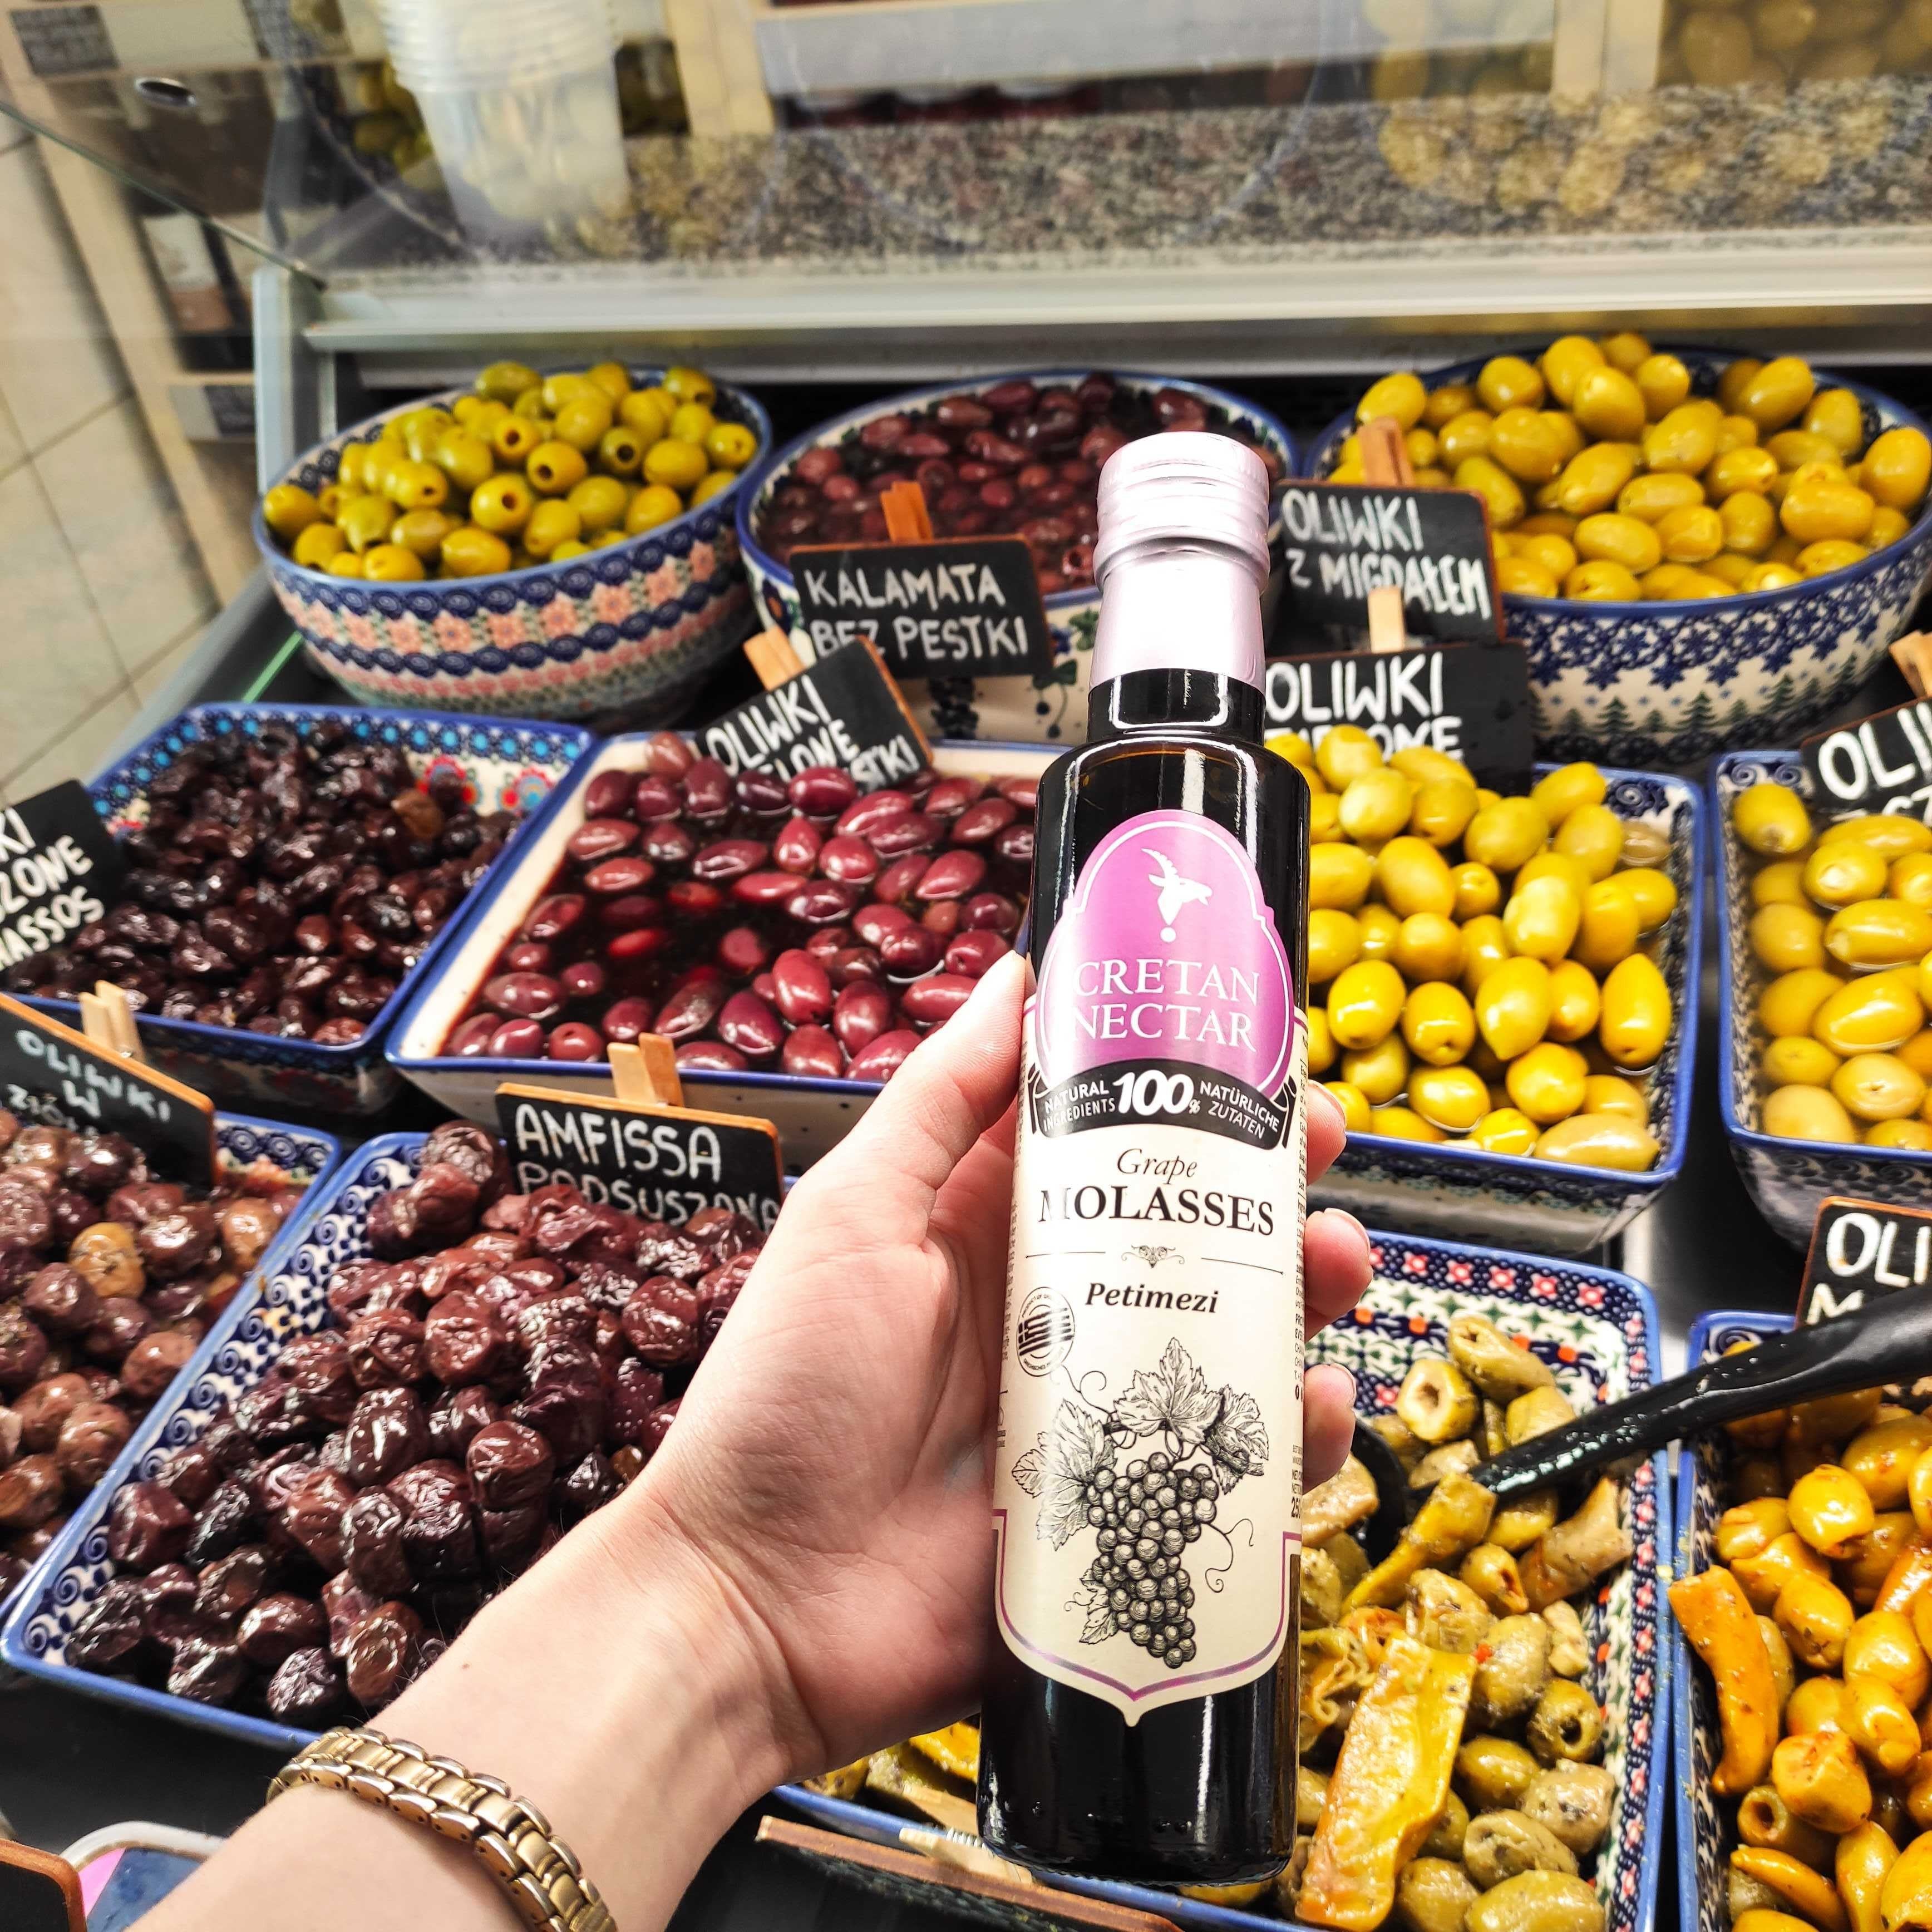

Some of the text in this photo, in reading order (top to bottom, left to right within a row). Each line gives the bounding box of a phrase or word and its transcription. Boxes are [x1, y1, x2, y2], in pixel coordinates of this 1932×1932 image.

[1282, 488, 1424, 551] OLIWKI
[805, 563, 1006, 611] KALAMATA
[1285, 548, 1312, 588] Z
[810, 615, 1029, 661] BEZ PESTKI
[1265, 652, 1443, 723] OLIWKI
[706, 674, 832, 777] OLIWKI
[842, 734, 920, 793] STKI
[1818, 702, 1932, 800] OLI
[0, 835, 93, 924] ZONE
[1072, 958, 1260, 1006] CRETAN
[1071, 1003, 1257, 1052] NECTAR
[15, 1029, 171, 1122] OLIWKI
[1044, 1080, 1110, 1114] NATURAL
[1043, 1097, 1116, 1132] INGREDIENTS
[1200, 1080, 1280, 1133] NATÜRLICHE
[1208, 1101, 1265, 1139] ZUTATEN
[515, 1103, 721, 1183] AMFISSA
[1117, 1148, 1197, 1185] Grape
[1038, 1185, 1274, 1236] MOLASSES
[1085, 1282, 1219, 1314] Petimezi
[1291, 1497, 1300, 1519] 25
